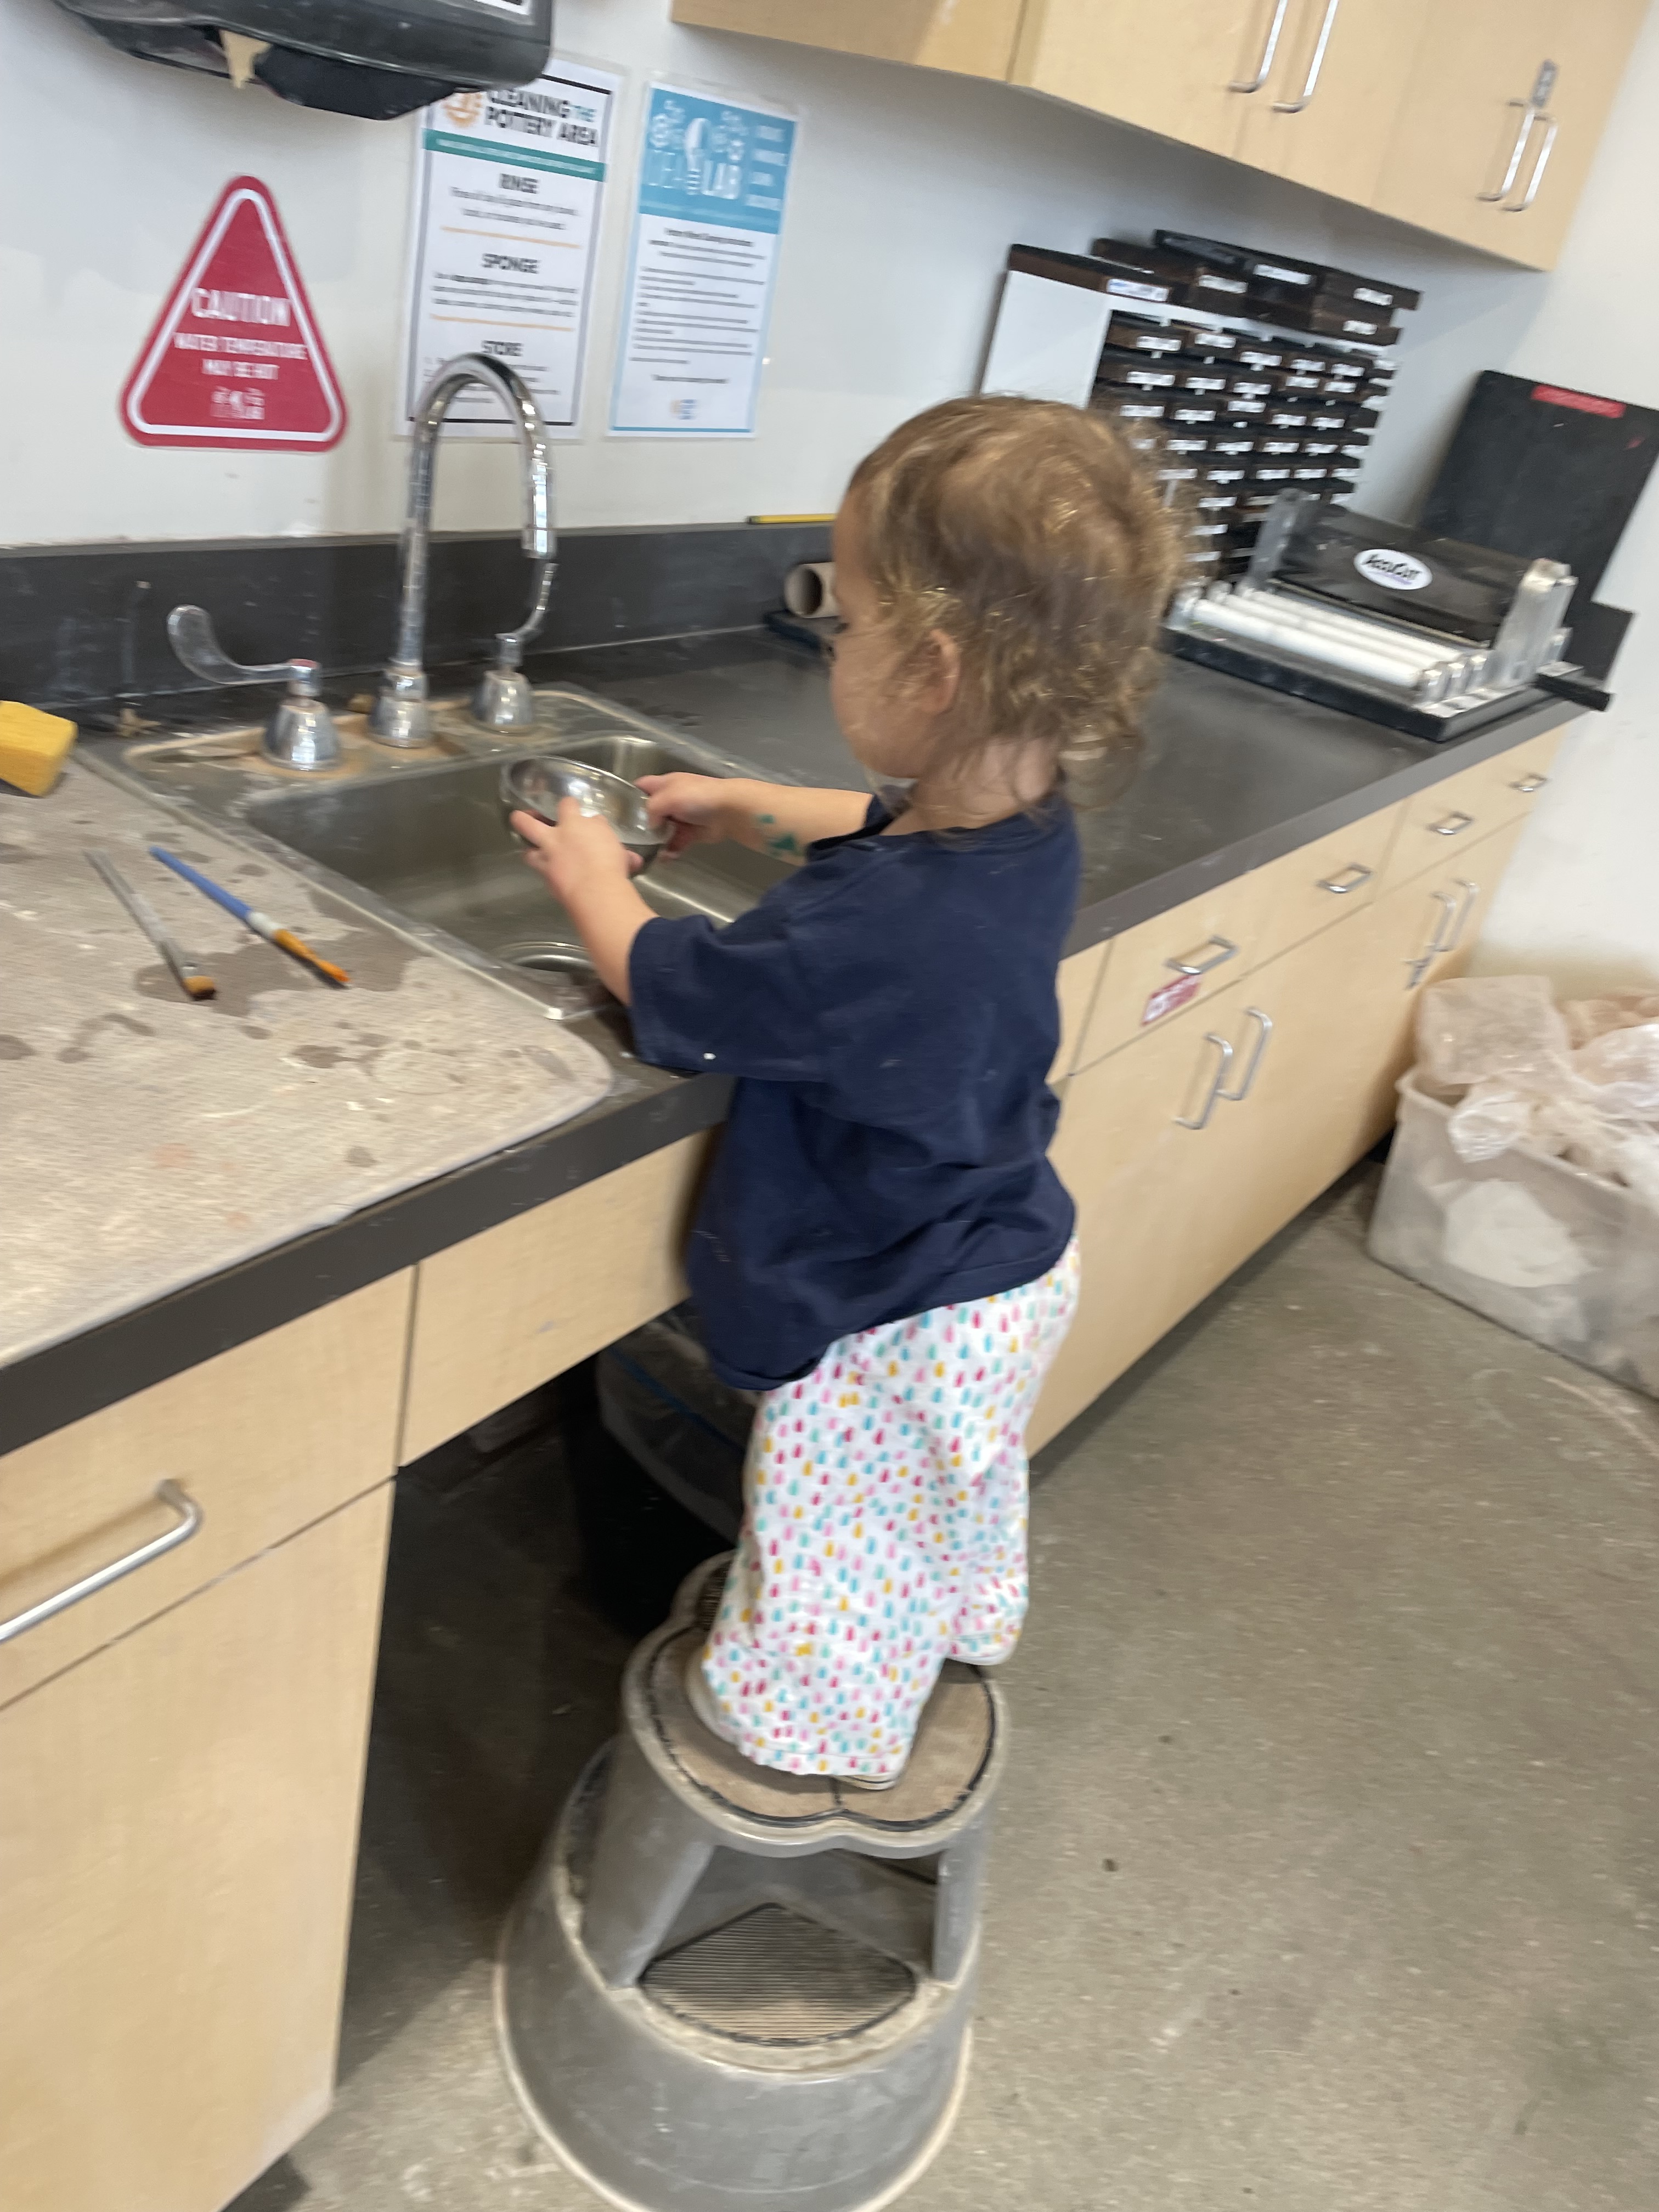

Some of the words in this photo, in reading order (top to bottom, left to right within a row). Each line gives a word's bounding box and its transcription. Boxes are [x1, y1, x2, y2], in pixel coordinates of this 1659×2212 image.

[484, 106, 556, 138] POTTERY
[557, 122, 599, 147] AREA
[481, 253, 541, 274] SPONGE
[191, 287, 291, 326] CAUTION
